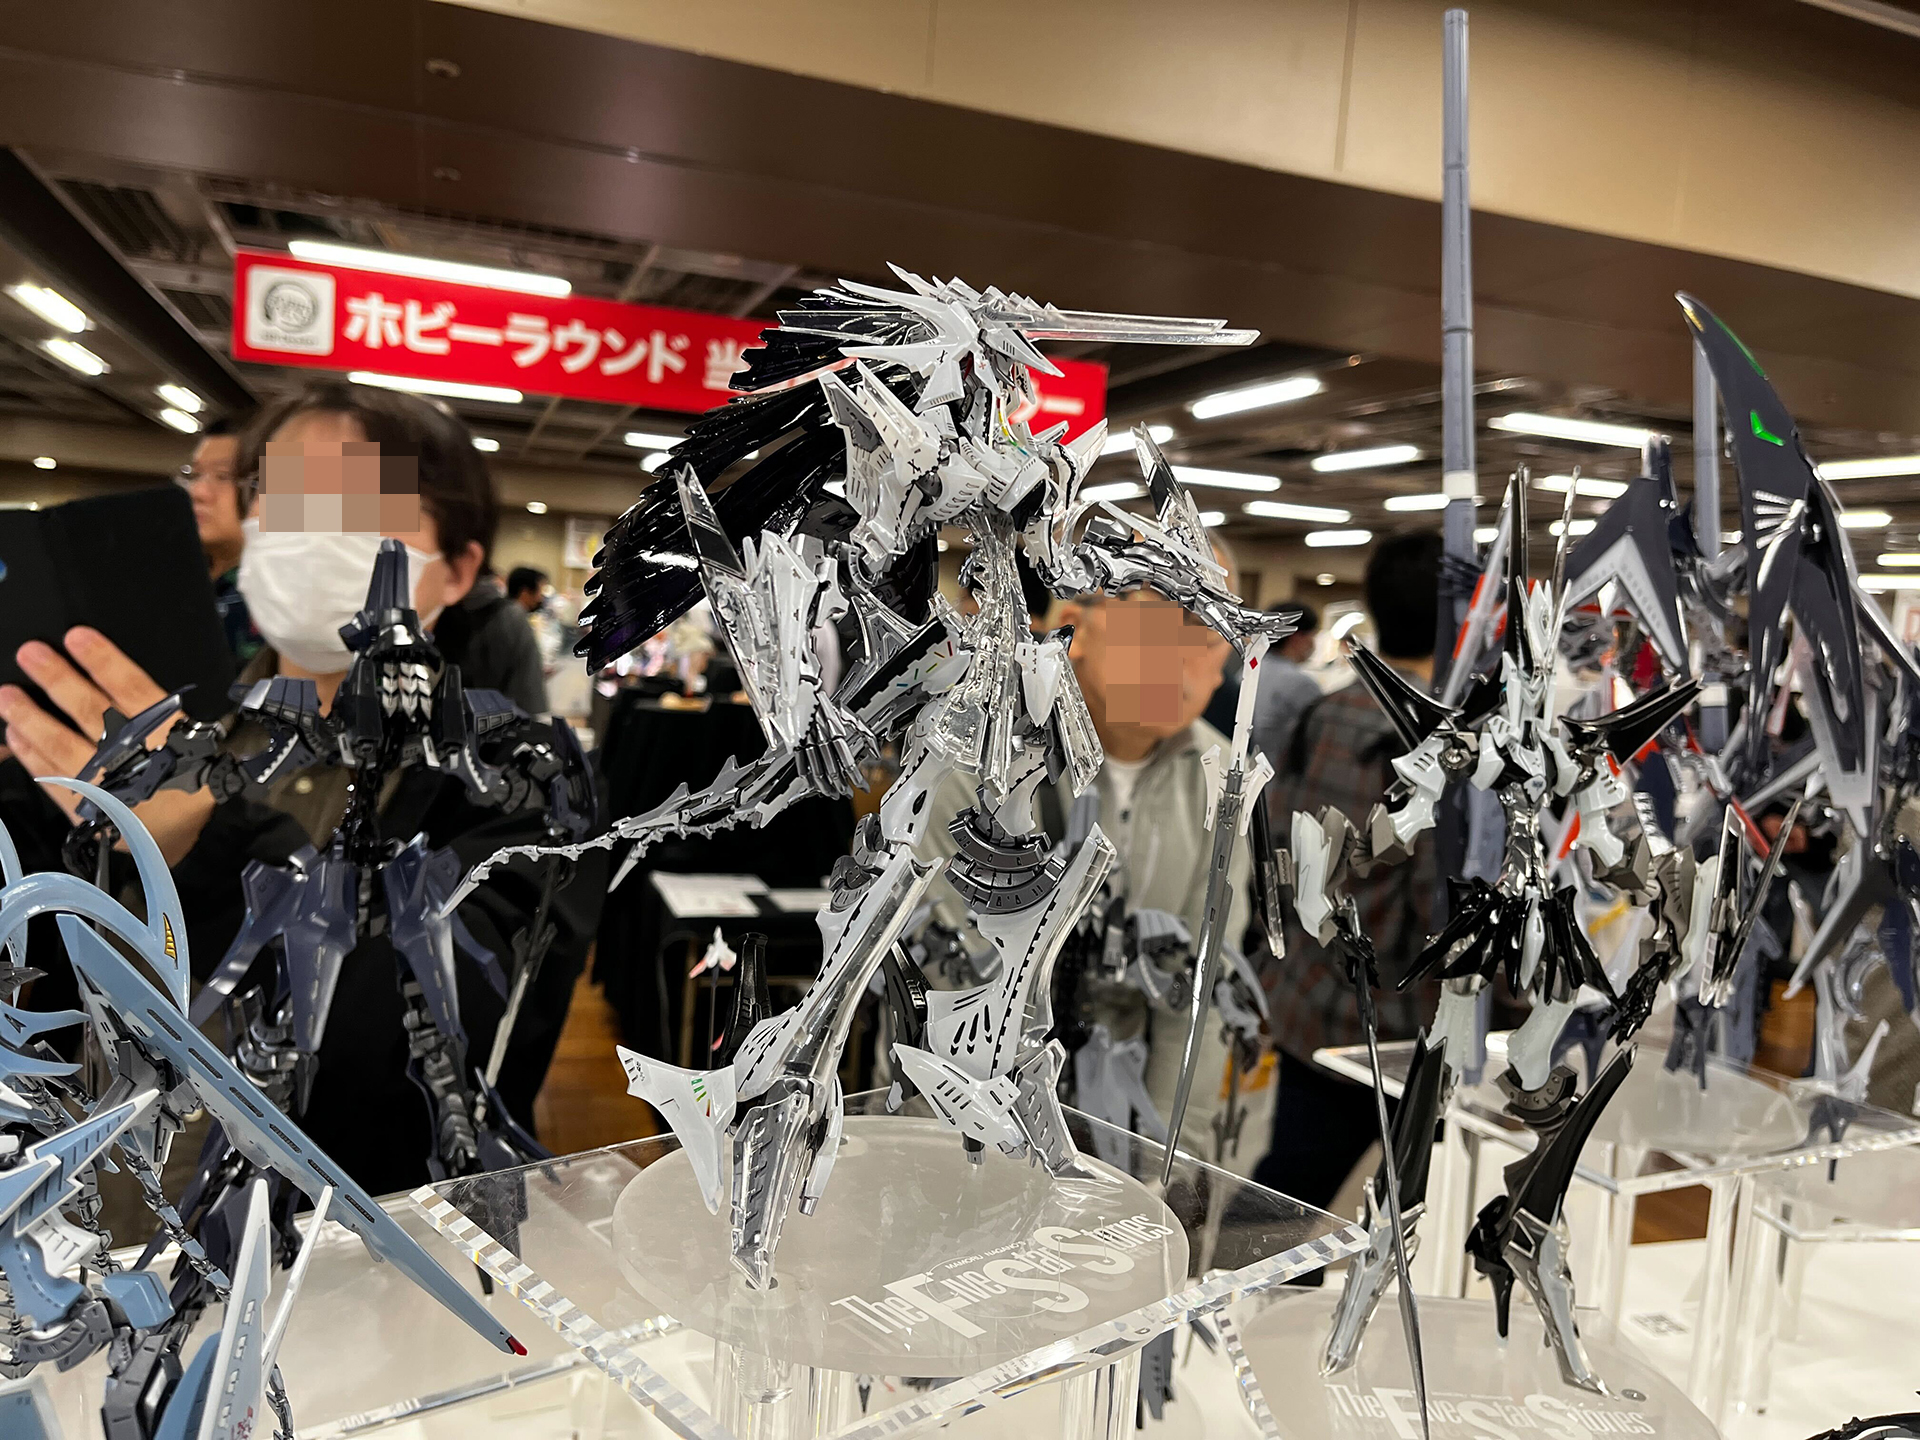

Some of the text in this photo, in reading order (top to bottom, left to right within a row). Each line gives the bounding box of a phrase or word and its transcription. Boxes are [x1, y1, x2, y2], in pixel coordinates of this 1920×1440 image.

[343, 292, 692, 384] ホビーラウンド
[830, 1294, 929, 1334] The
[983, 1245, 1090, 1313] Star
[944, 1254, 984, 1270] MAMORU
[1324, 1384, 1386, 1418] The
